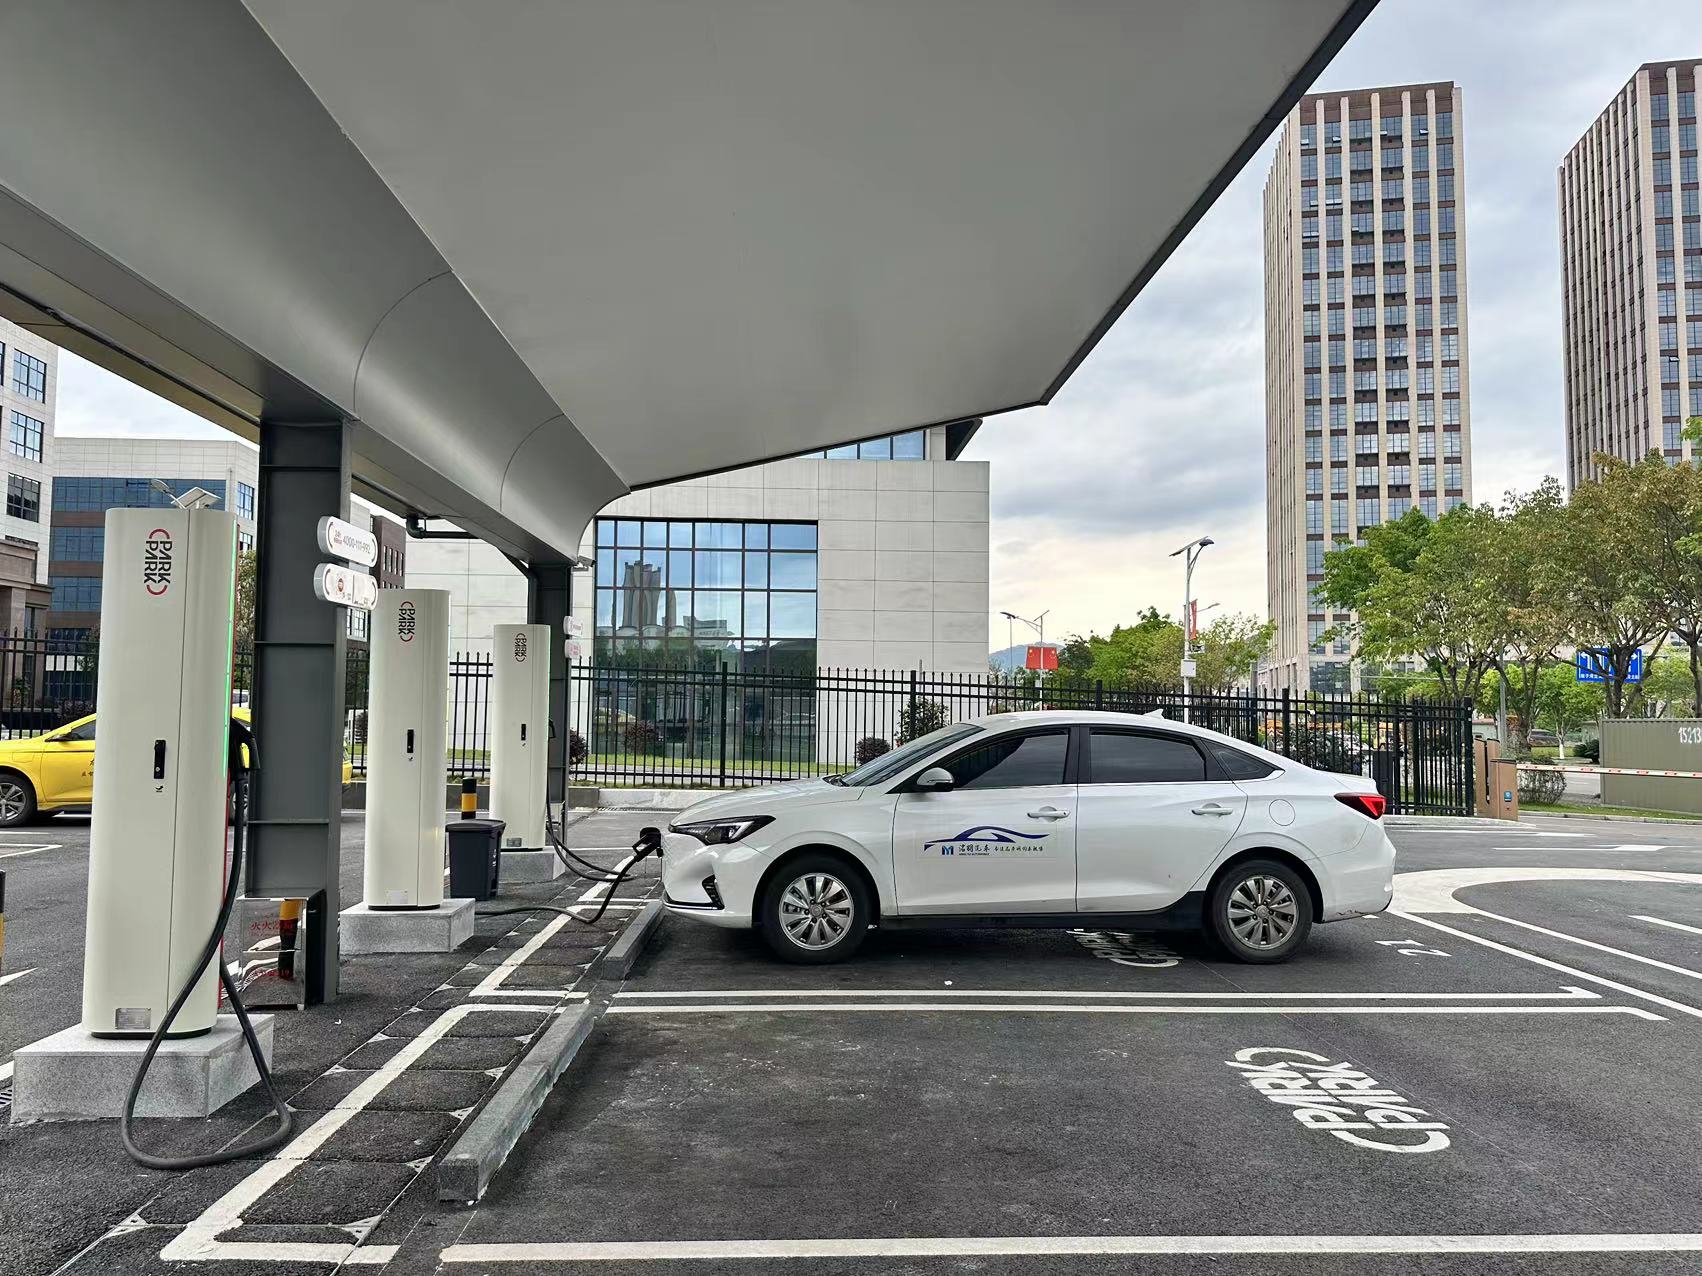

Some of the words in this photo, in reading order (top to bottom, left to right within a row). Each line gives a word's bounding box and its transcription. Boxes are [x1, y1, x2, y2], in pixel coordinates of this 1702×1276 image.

[144, 541, 158, 584] PARK
[158, 541, 172, 584] PARK
[398, 608, 407, 634] PARK
[407, 608, 415, 634] PARK
[1678, 726, 1702, 744] 15213
[1224, 1061, 1375, 1128] PARK
[1288, 1061, 1450, 1129] PARK
